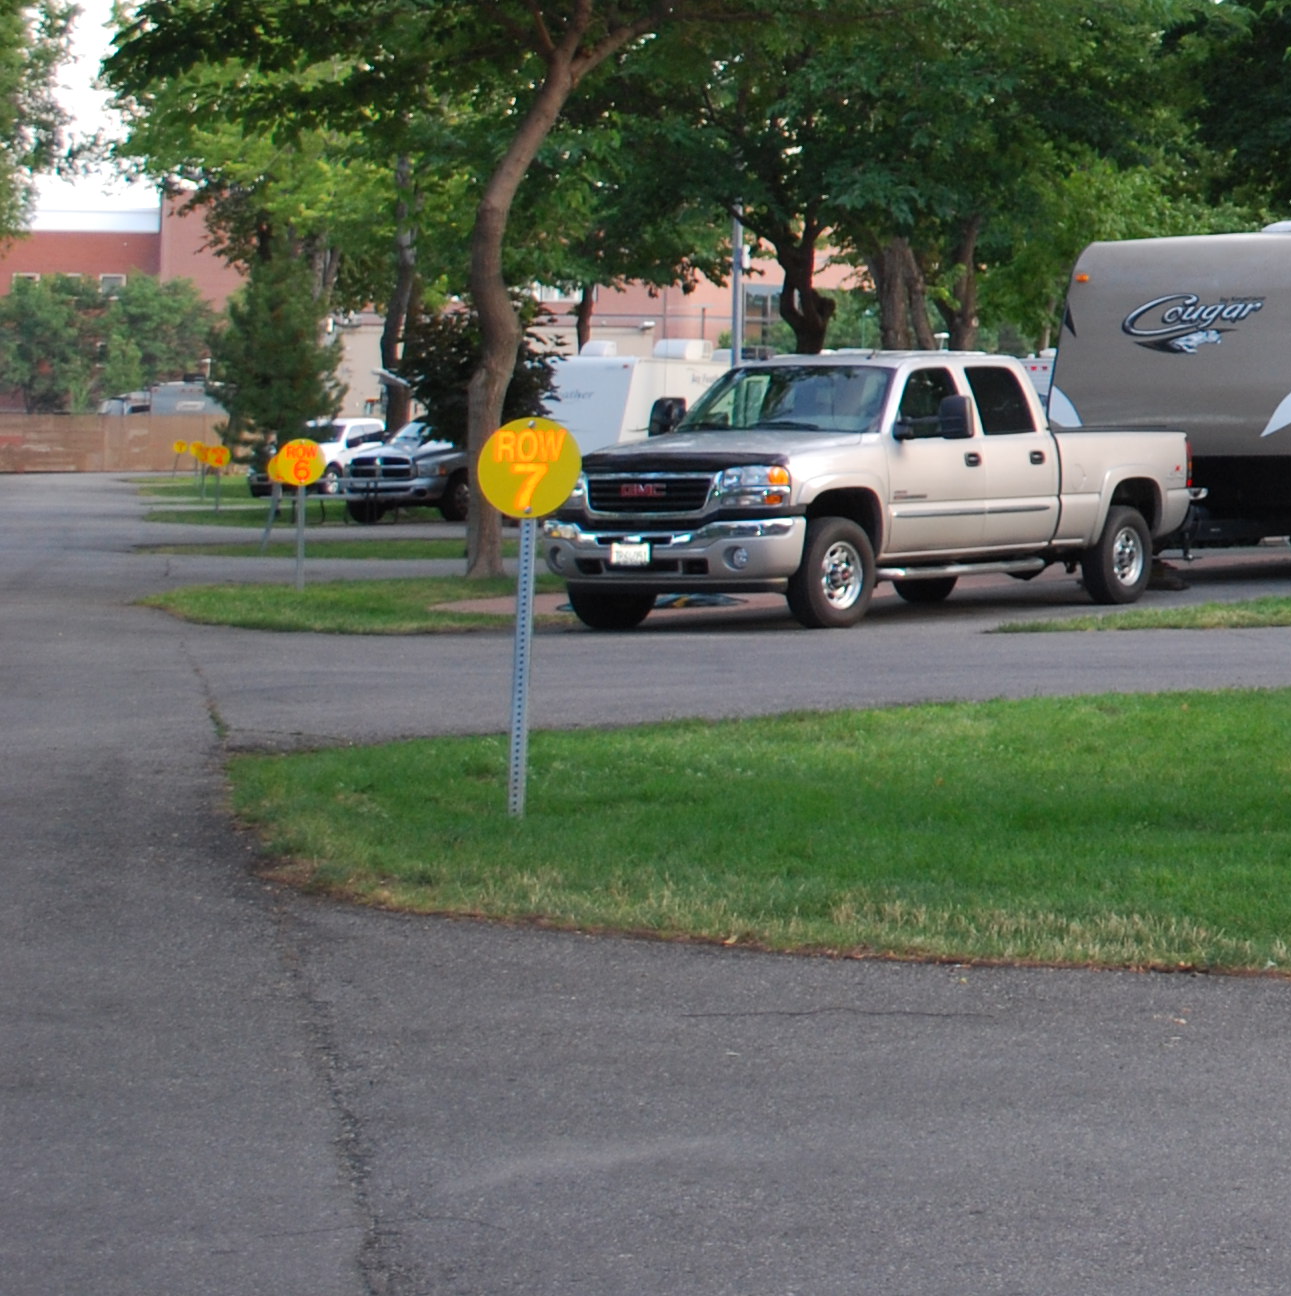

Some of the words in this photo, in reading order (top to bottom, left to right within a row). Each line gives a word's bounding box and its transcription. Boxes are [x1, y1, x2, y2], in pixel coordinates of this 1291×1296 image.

[1121, 292, 1264, 337] Cougar
[286, 444, 319, 459] ROW
[492, 428, 567, 463] ROW
[293, 459, 312, 481] 6
[509, 462, 549, 510] 7
[620, 483, 667, 497] GMC
